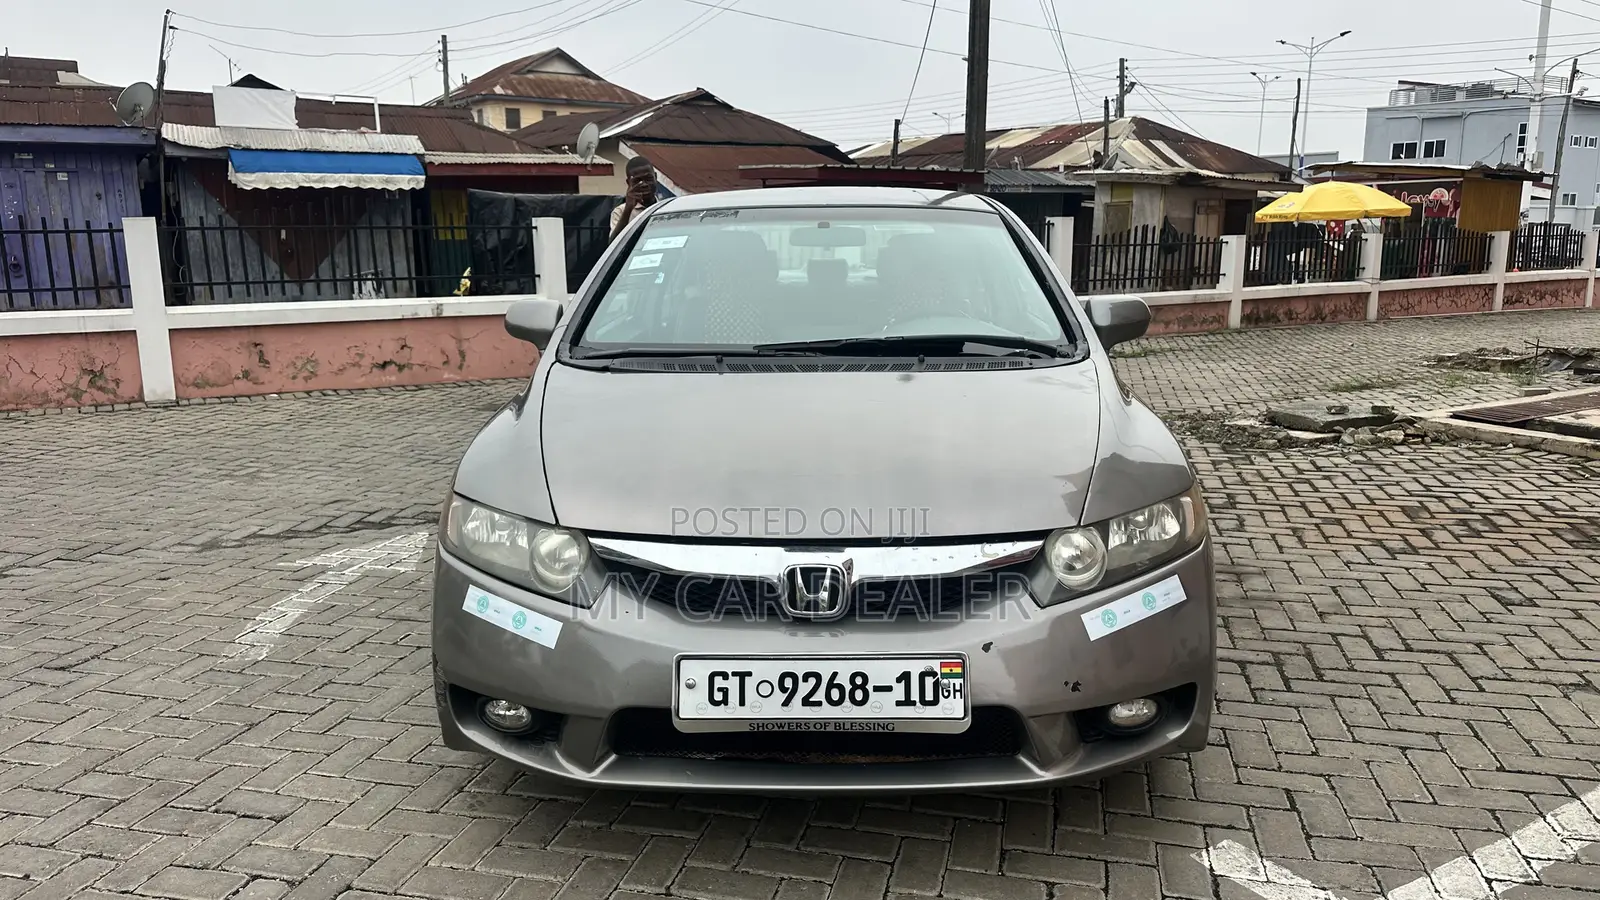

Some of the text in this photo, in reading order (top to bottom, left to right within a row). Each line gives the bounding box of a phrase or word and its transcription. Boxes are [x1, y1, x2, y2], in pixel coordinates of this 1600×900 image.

[941, 682, 963, 699] GH
[748, 722, 895, 732] SHOWERS OF BLESSING
